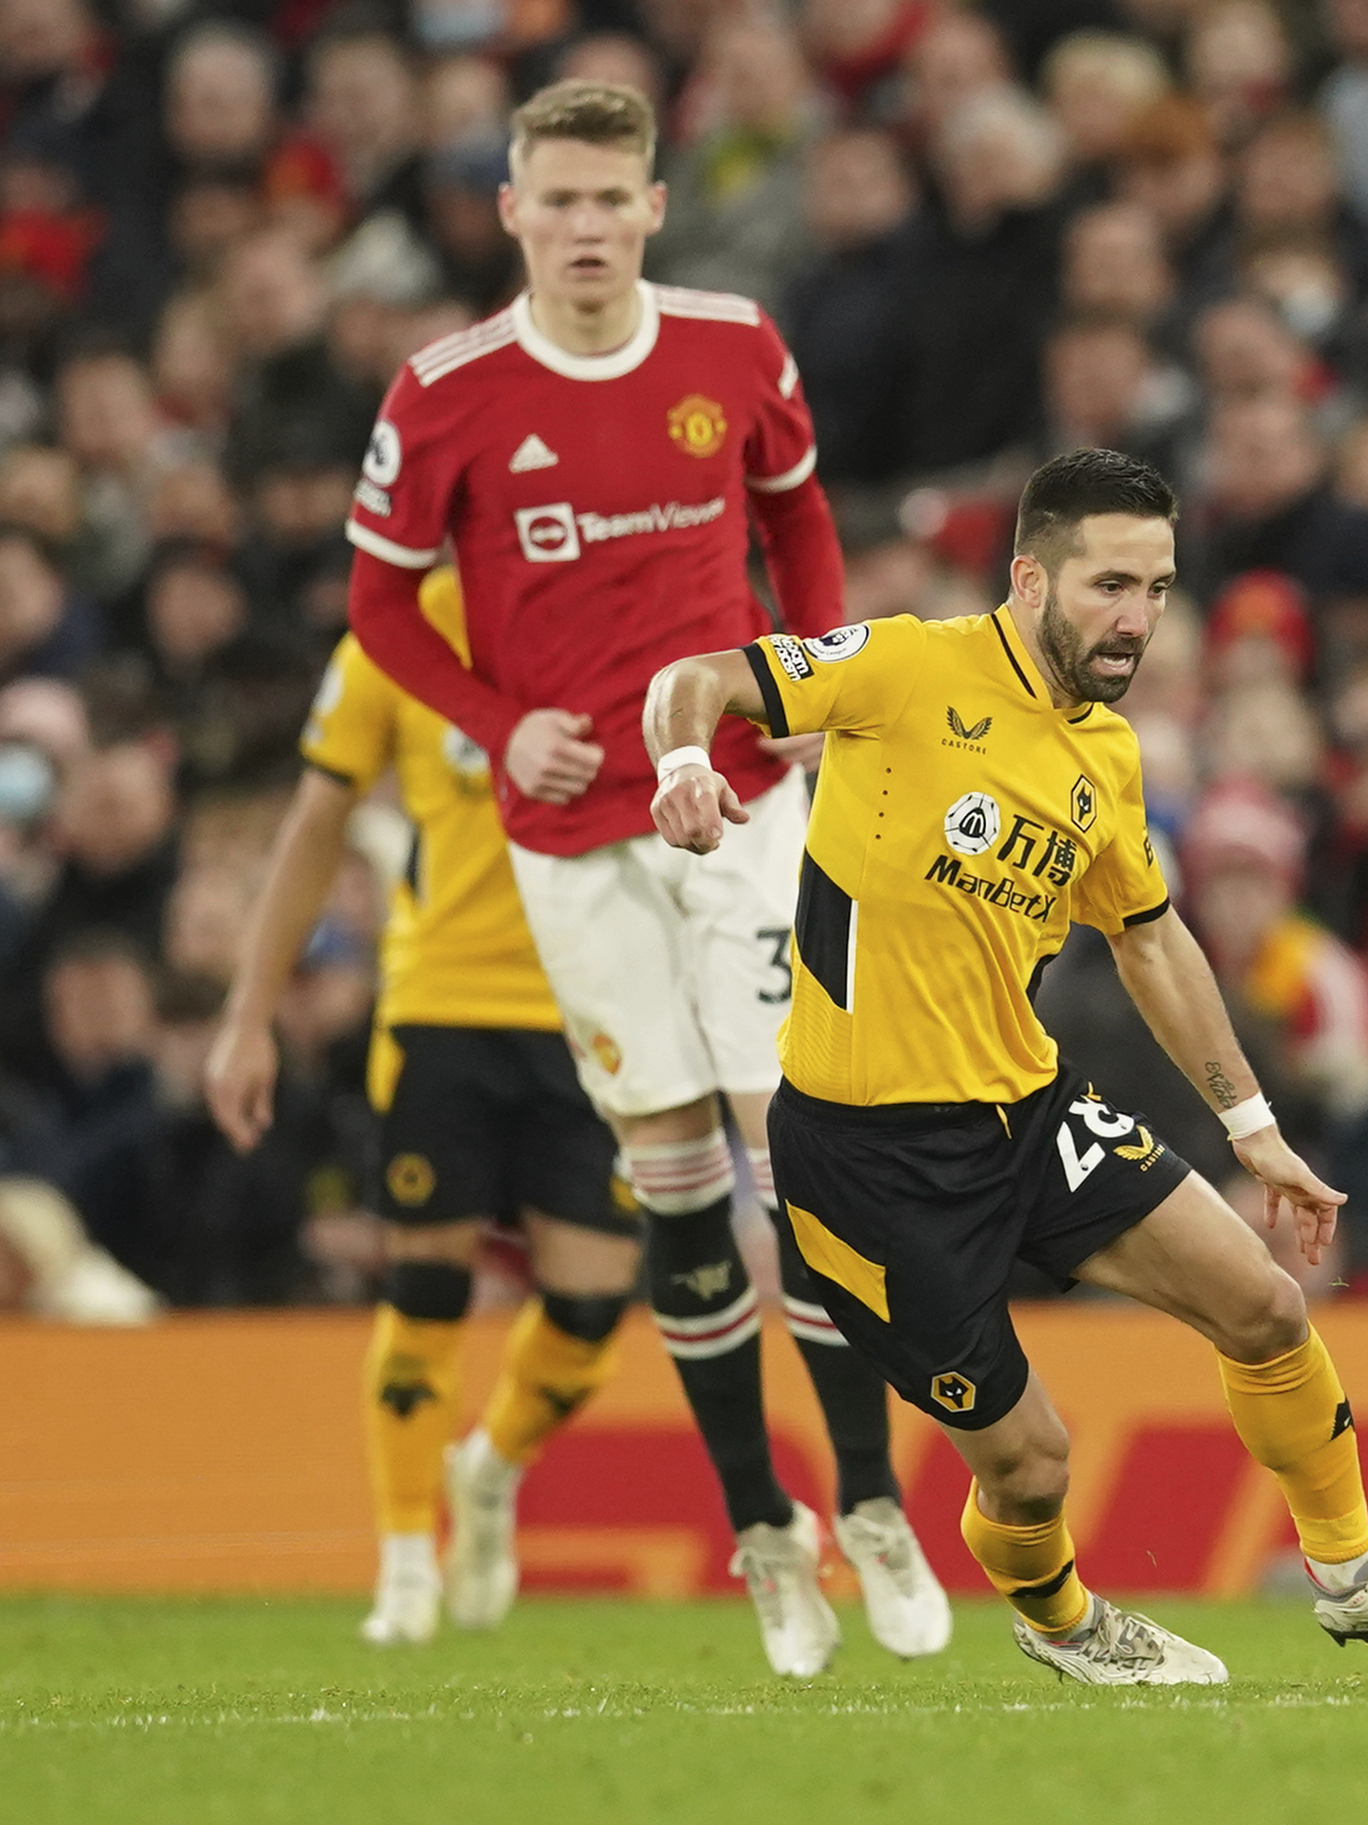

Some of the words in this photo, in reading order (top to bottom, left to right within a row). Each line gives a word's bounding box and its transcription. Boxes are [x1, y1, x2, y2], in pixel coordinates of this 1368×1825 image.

[941, 737, 988, 755] CASTORE
[996, 813, 1077, 887] 万博
[924, 854, 1057, 923] ManBetX
